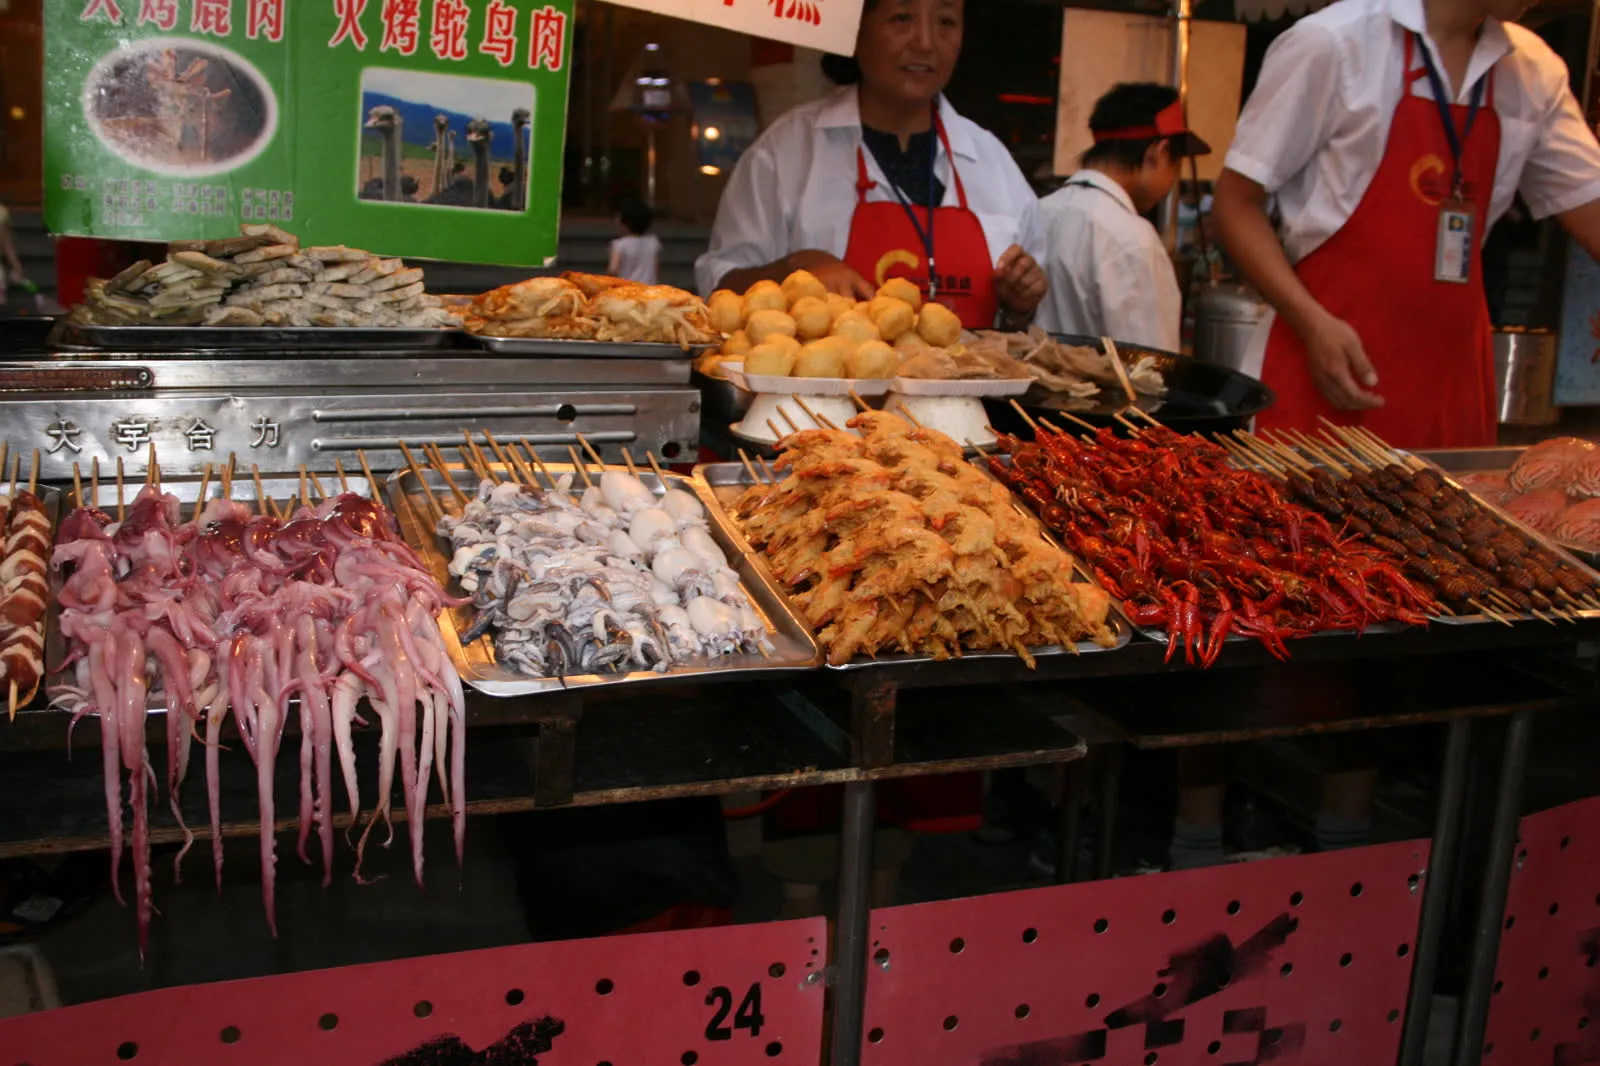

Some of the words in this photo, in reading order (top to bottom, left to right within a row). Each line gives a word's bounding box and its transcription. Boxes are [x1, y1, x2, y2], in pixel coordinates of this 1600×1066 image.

[328, 0, 566, 71] 火烤鸵鸟肉
[47, 415, 281, 452] 大宇合力
[704, 982, 765, 1041] 24
